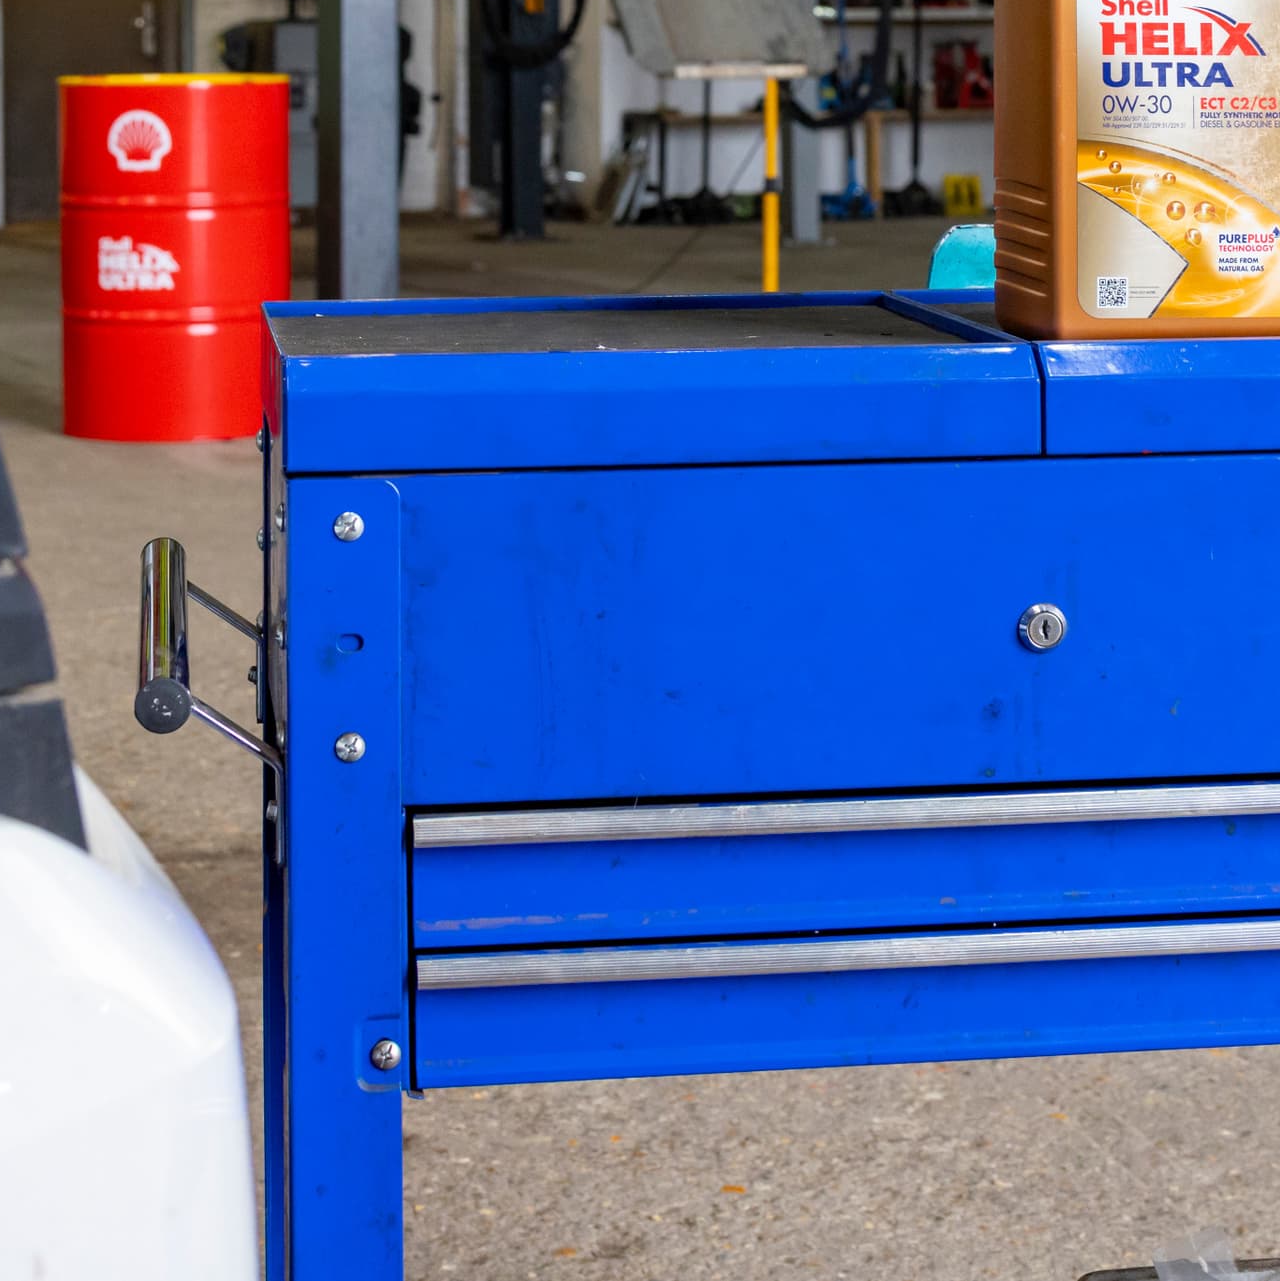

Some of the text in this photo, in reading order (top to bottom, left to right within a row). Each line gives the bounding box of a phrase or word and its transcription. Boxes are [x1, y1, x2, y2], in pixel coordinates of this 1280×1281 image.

[1099, 18, 1263, 56] HELIX
[1102, 62, 1234, 88] ULTRA
[1102, 94, 1173, 114] 0W-30
[1200, 96, 1278, 111] ECT C2/C3
[1200, 111, 1221, 119] FULLY
[1223, 111, 1263, 119] SYNTHETIC
[1200, 120, 1224, 128] DIESEL
[1226, 120, 1232, 128] &
[1233, 120, 1273, 128] GASOLINE
[1218, 233, 1275, 244] PUREPLUS
